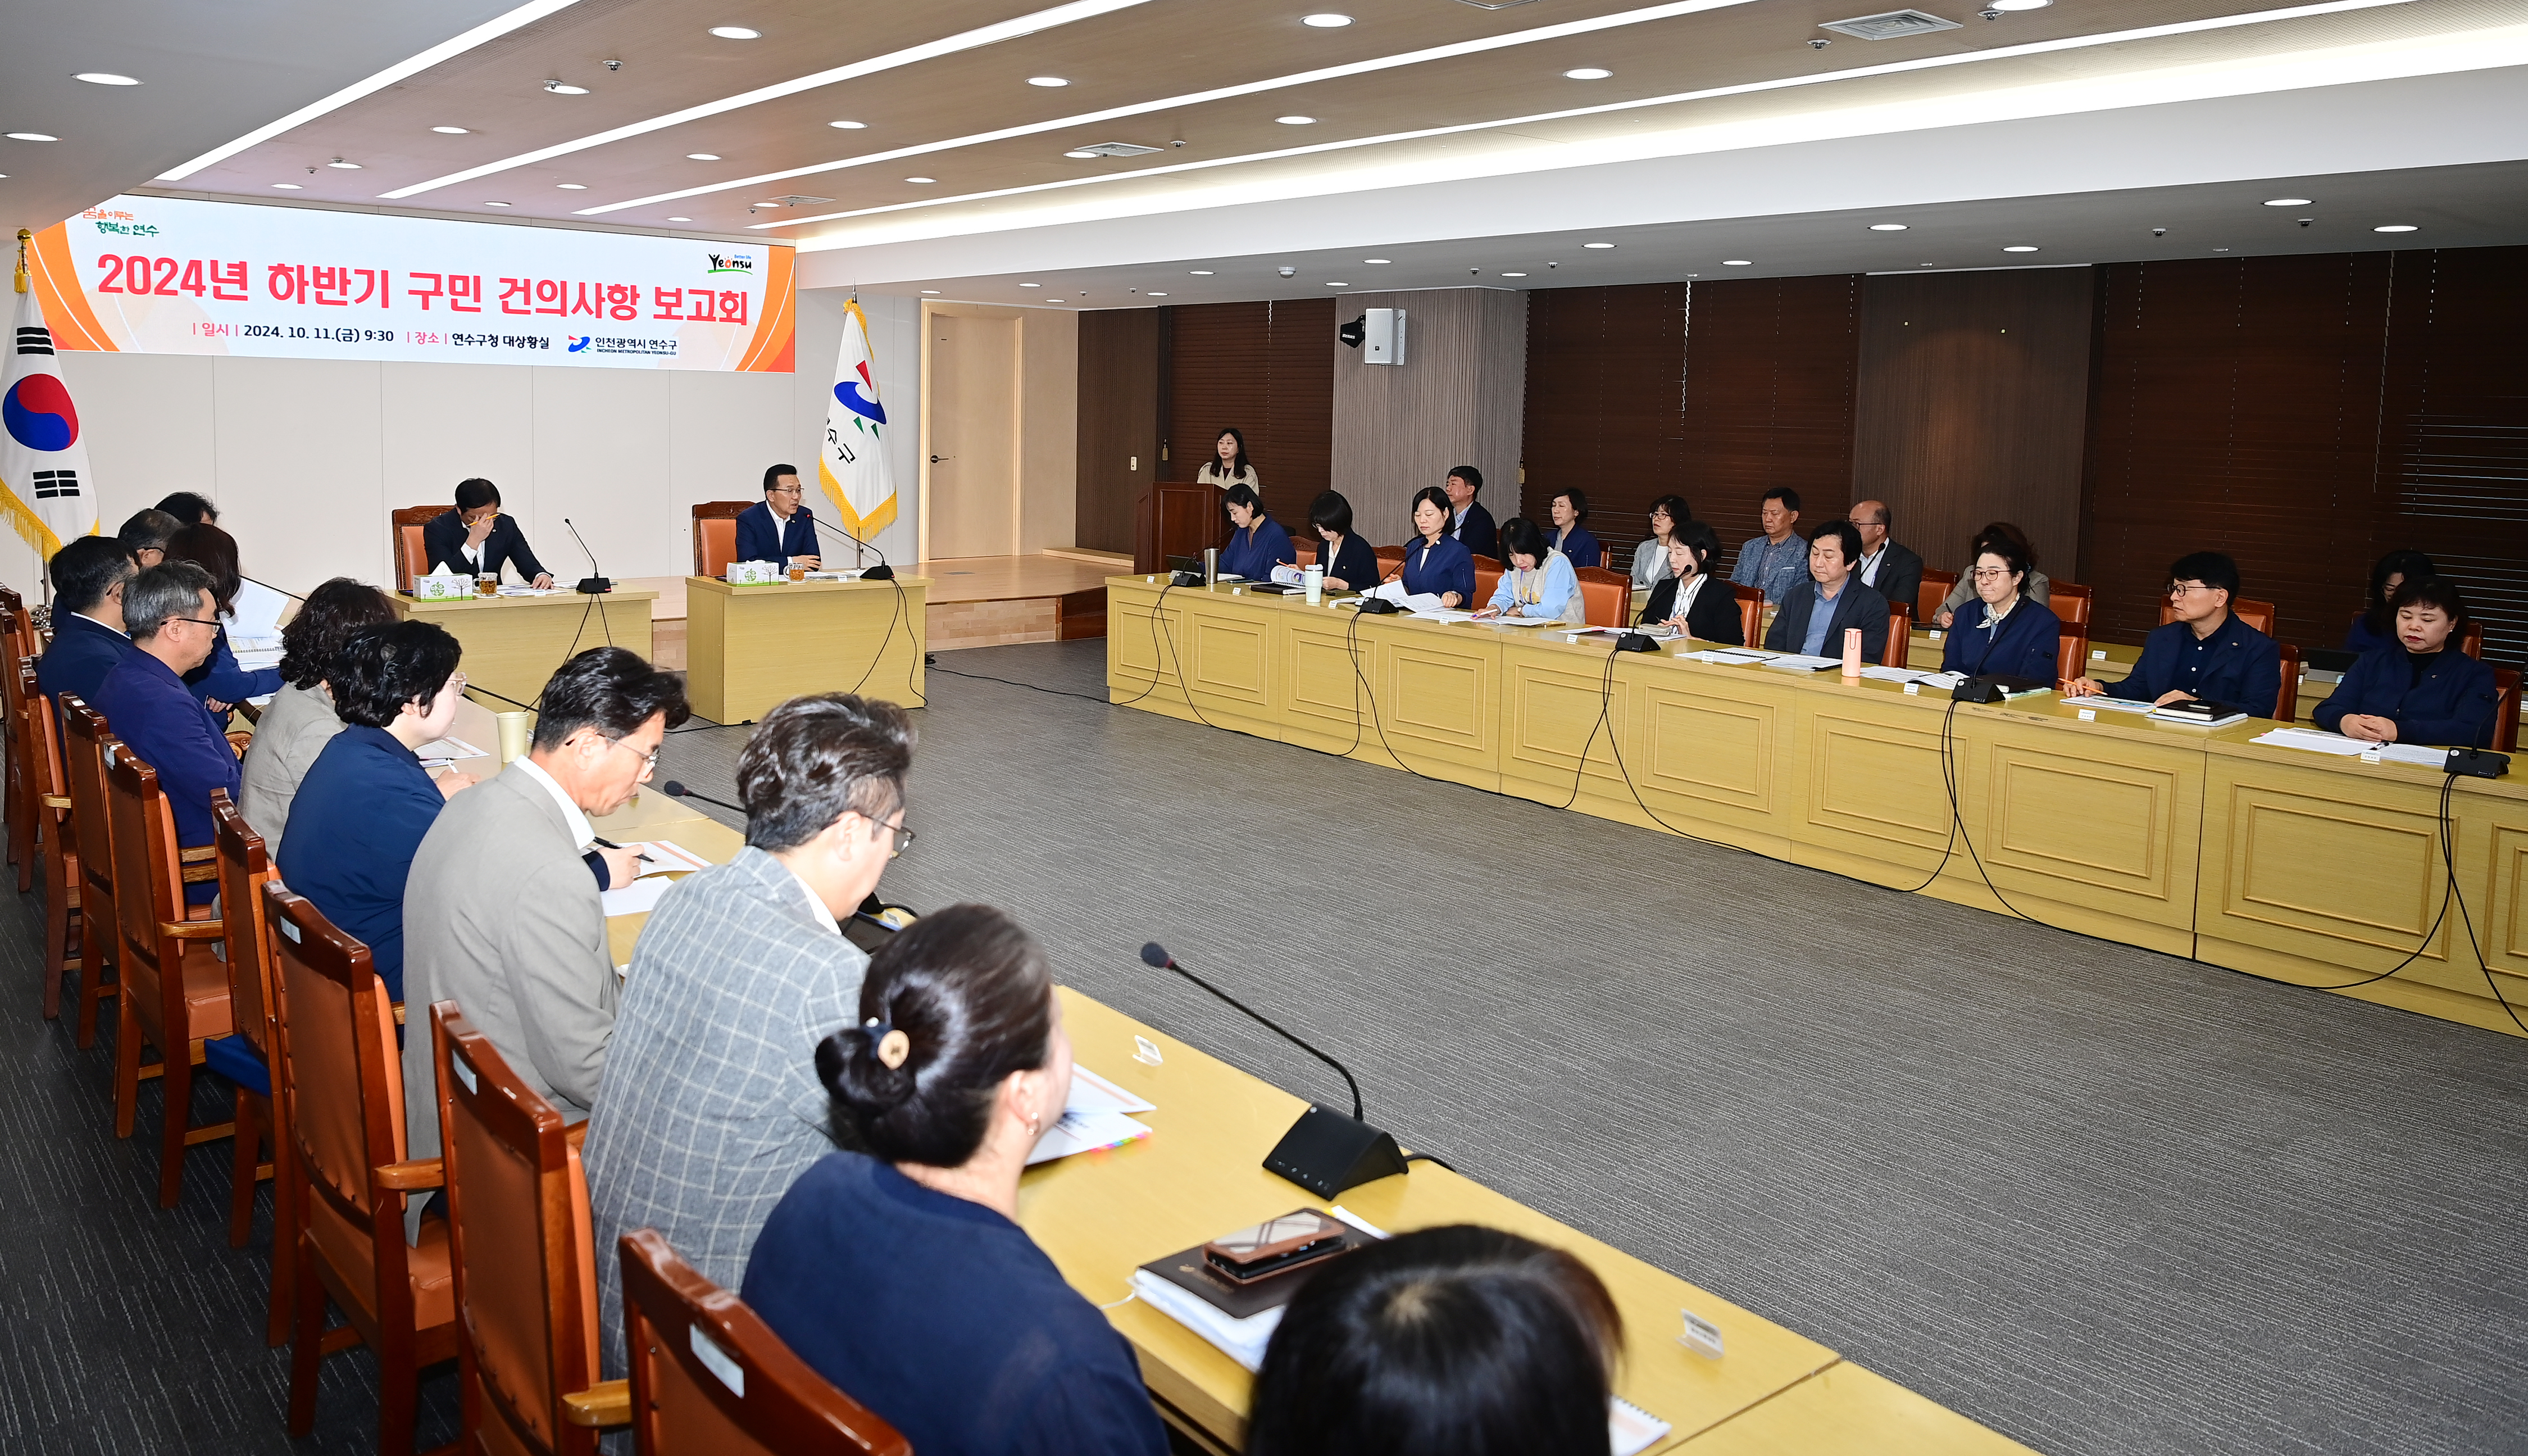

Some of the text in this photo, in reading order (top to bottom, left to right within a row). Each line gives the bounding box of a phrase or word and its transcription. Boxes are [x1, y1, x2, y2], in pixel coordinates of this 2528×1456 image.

[95, 221, 160, 238] 행복한 연수
[708, 253, 752, 271] Yeonsu
[98, 254, 748, 326] 2024년 하반기 구민 건의사항 보고회
[202, 322, 394, 343] 일시 2024. 10. 11.(금) 9:30
[415, 331, 549, 349] 장소 연수구청 대상황실
[595, 337, 678, 351] 인천광역시 연수구
